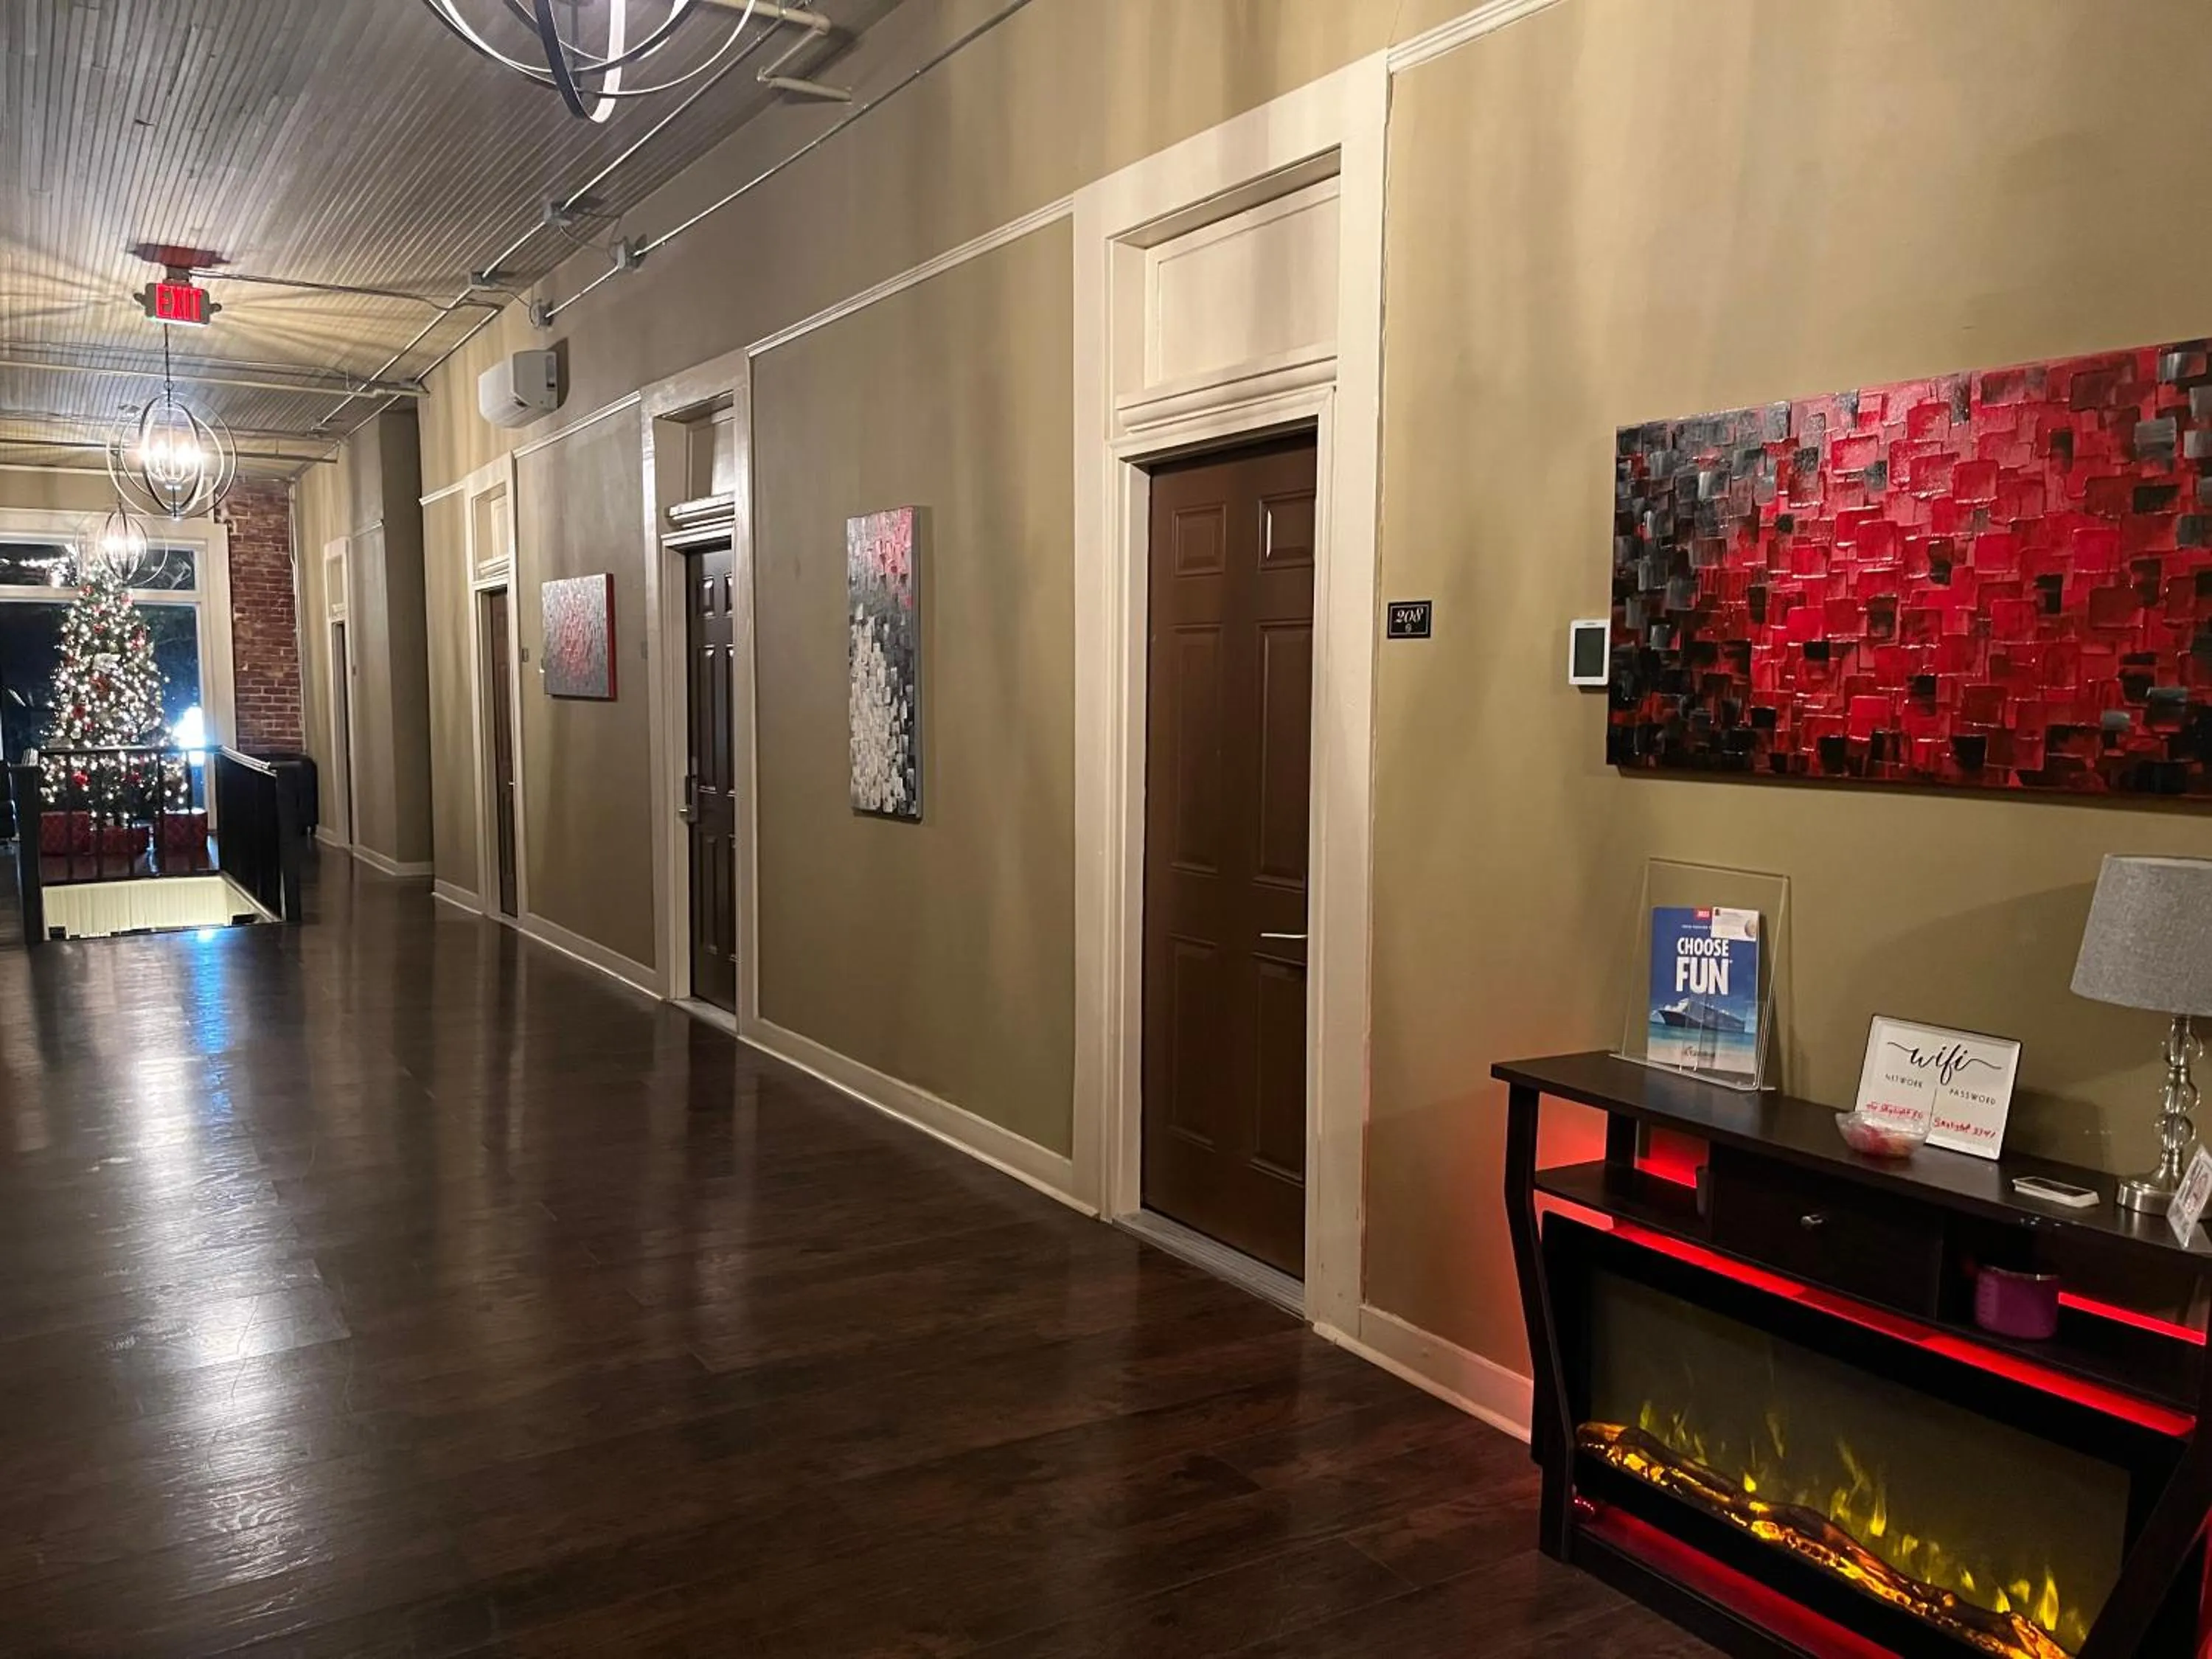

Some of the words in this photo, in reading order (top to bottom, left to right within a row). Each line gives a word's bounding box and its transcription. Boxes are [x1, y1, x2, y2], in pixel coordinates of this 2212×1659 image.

[156, 284, 202, 321] EXIT
[1394, 607, 1424, 623] 208
[1677, 937, 1729, 956] CHOOSE
[1675, 956, 1729, 995] FUN
[1887, 1043, 2002, 1086] wifi
[1885, 1074, 1923, 1089] NETWORK
[1949, 1088, 1997, 1106] PASSWORD
